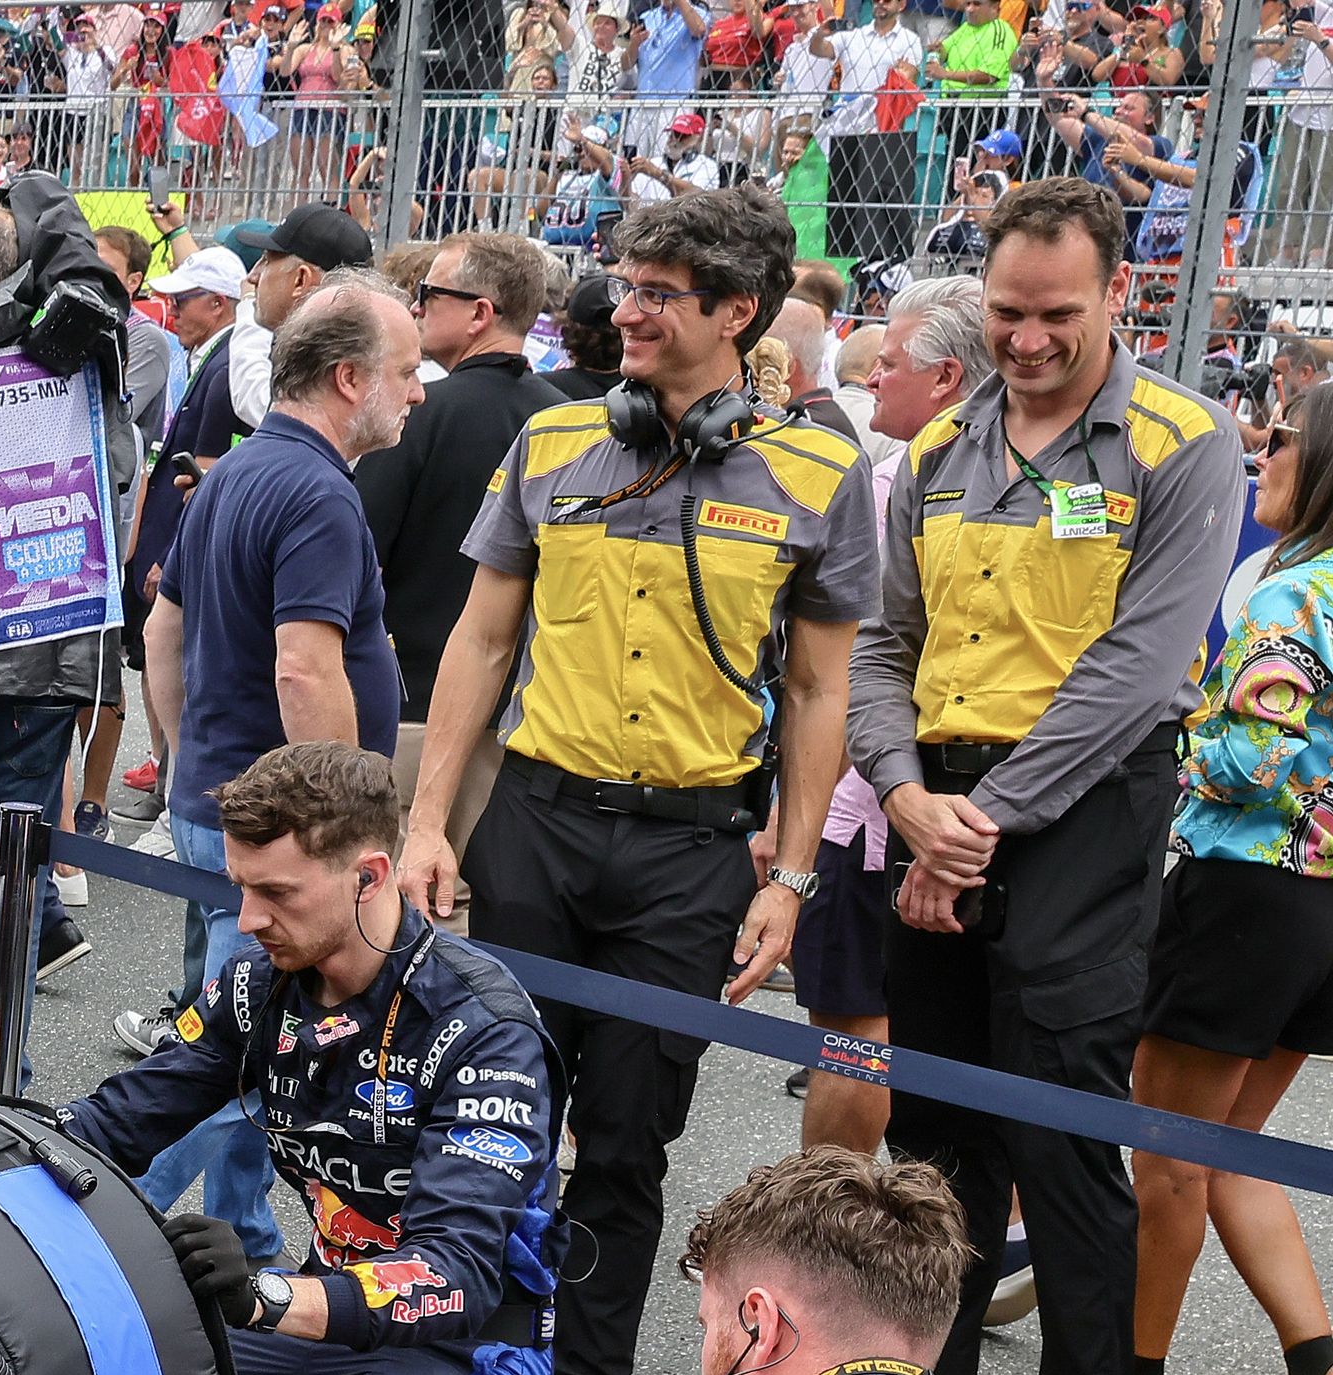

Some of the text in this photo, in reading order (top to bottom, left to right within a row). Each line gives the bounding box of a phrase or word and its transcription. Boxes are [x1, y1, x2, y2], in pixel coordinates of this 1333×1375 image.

[707, 504, 780, 534] PIRELLI
[1060, 525, 1105, 538] SPRINT
[3, 531, 86, 568] COURSE
[8, 622, 32, 638] FIA
[233, 959, 252, 1034] sparco
[314, 1025, 337, 1047] Red
[335, 1019, 360, 1042] Bull
[823, 1033, 893, 1061] ORACLE
[420, 1018, 468, 1088] sparco
[820, 1046, 858, 1065] Red Bull
[477, 1067, 537, 1089] 1Password
[817, 1061, 888, 1085] RACING
[348, 1107, 416, 1127] RAING
[374, 1088, 385, 1124] ACCESS
[457, 1096, 534, 1126] ROKT
[461, 1127, 520, 1159] Ford
[47, 1153, 62, 1167] 109
[424, 1288, 465, 1319] Bull
[844, 1358, 876, 1375] PIT
[877, 1360, 897, 1372] ALL
